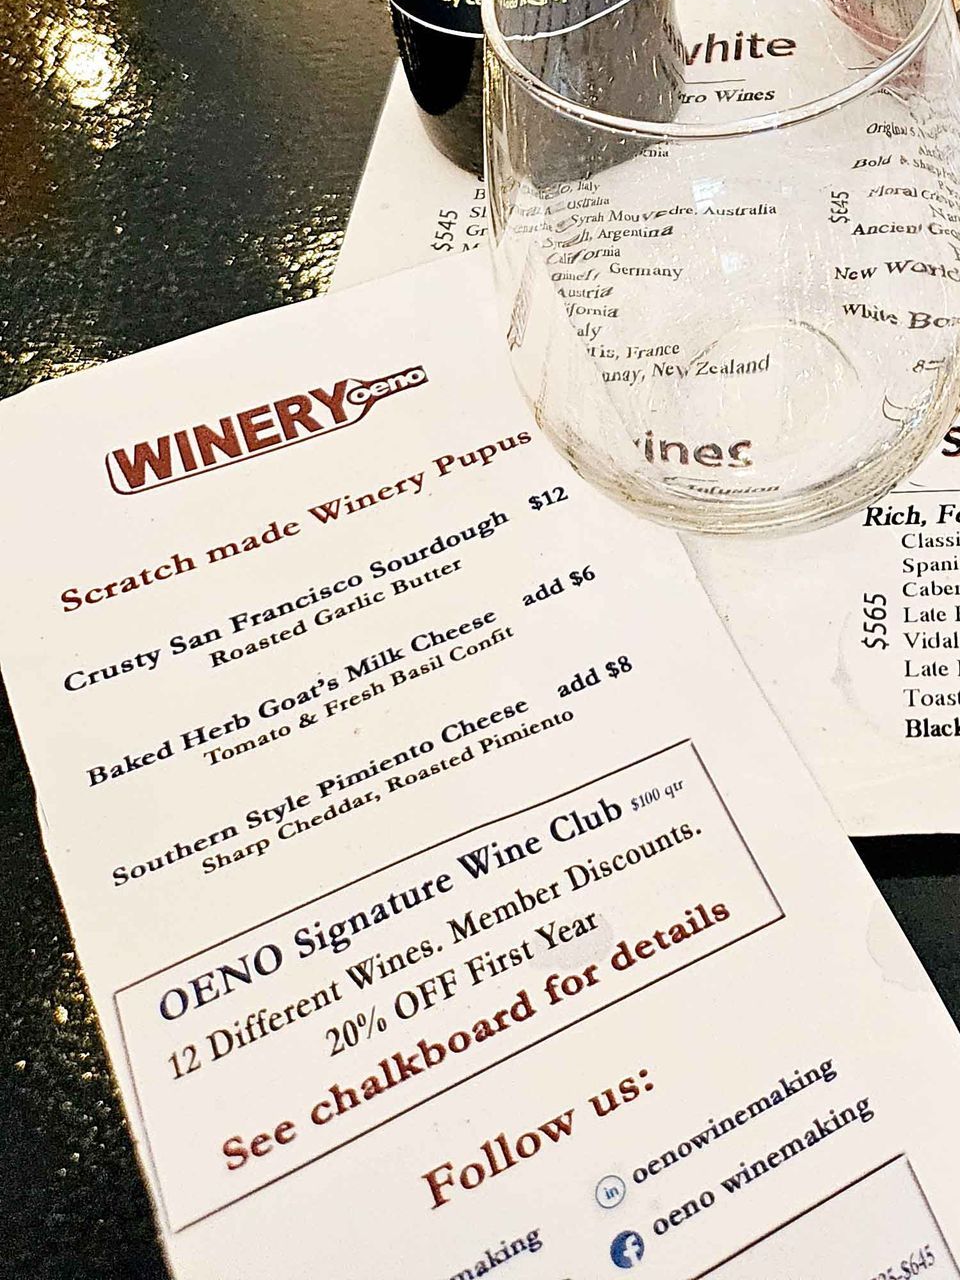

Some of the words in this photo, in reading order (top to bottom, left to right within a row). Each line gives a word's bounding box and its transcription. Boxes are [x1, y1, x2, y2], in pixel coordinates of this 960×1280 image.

[715, 89, 776, 104] Wines
[431, 209, 458, 252] $545
[598, 224, 674, 241] Argentina
[609, 263, 684, 281] Germany
[705, 204, 777, 216] Australia
[112, 379, 349, 489] WINERY
[345, 366, 427, 405] oeno
[695, 353, 770, 378] Zealand
[60, 553, 198, 613] Scratch
[205, 521, 301, 564] made
[306, 471, 425, 525] Winery
[431, 431, 532, 478] Pupus
[860, 504, 927, 528] Rich,
[63, 648, 162, 692] Crusty
[169, 628, 223, 656] San
[228, 574, 364, 635] Francisco
[369, 511, 510, 579] Sourdough
[527, 486, 569, 512] $12
[208, 619, 309, 669] Roasted
[313, 591, 386, 626] Garlic
[389, 559, 462, 596] Butter
[861, 593, 889, 650] $565
[903, 606, 947, 624] Late
[85, 739, 176, 788] Baked
[179, 713, 251, 751] Herb
[257, 677, 340, 719] Goat's
[343, 647, 406, 683] Milk
[410, 611, 497, 652] Cheese
[522, 577, 566, 607] add
[568, 564, 596, 588] $6
[203, 725, 292, 766] Tomato
[298, 712, 319, 729] &
[323, 681, 386, 718] Fresh
[389, 654, 445, 687] Basil
[449, 626, 515, 662] Confit
[112, 825, 240, 887] Southern
[245, 794, 312, 830] Style
[315, 740, 435, 799] Pimiento
[440, 700, 529, 744] Cheese
[557, 666, 602, 699] add
[604, 655, 633, 680] $8
[201, 838, 271, 875] Sharp
[277, 791, 382, 840] Cheddar,
[384, 745, 476, 794] Roasted
[477, 710, 574, 755] Pimiento
[159, 943, 283, 1021] OENO
[293, 873, 454, 959] Signature
[456, 836, 543, 880] Wine
[549, 797, 623, 843] Club
[630, 788, 661, 812] $100
[167, 1044, 202, 1081] 12
[205, 980, 343, 1062] Different
[344, 939, 444, 991] Wines.
[445, 881, 562, 945] Member
[563, 823, 702, 892] Discounts.
[222, 1120, 297, 1171] See
[310, 989, 538, 1126] chalkboard
[543, 964, 601, 1006] for
[610, 903, 731, 972] details
[325, 1005, 388, 1058] 20%
[394, 968, 458, 1020] OFF
[463, 939, 535, 987] First
[533, 912, 599, 951] Year
[420, 1108, 575, 1211] Follow
[587, 1068, 654, 1118] us:
[632, 1058, 838, 1184] oenowinemaking
[652, 1190, 716, 1236] oeno
[719, 1096, 875, 1194] winemaking
